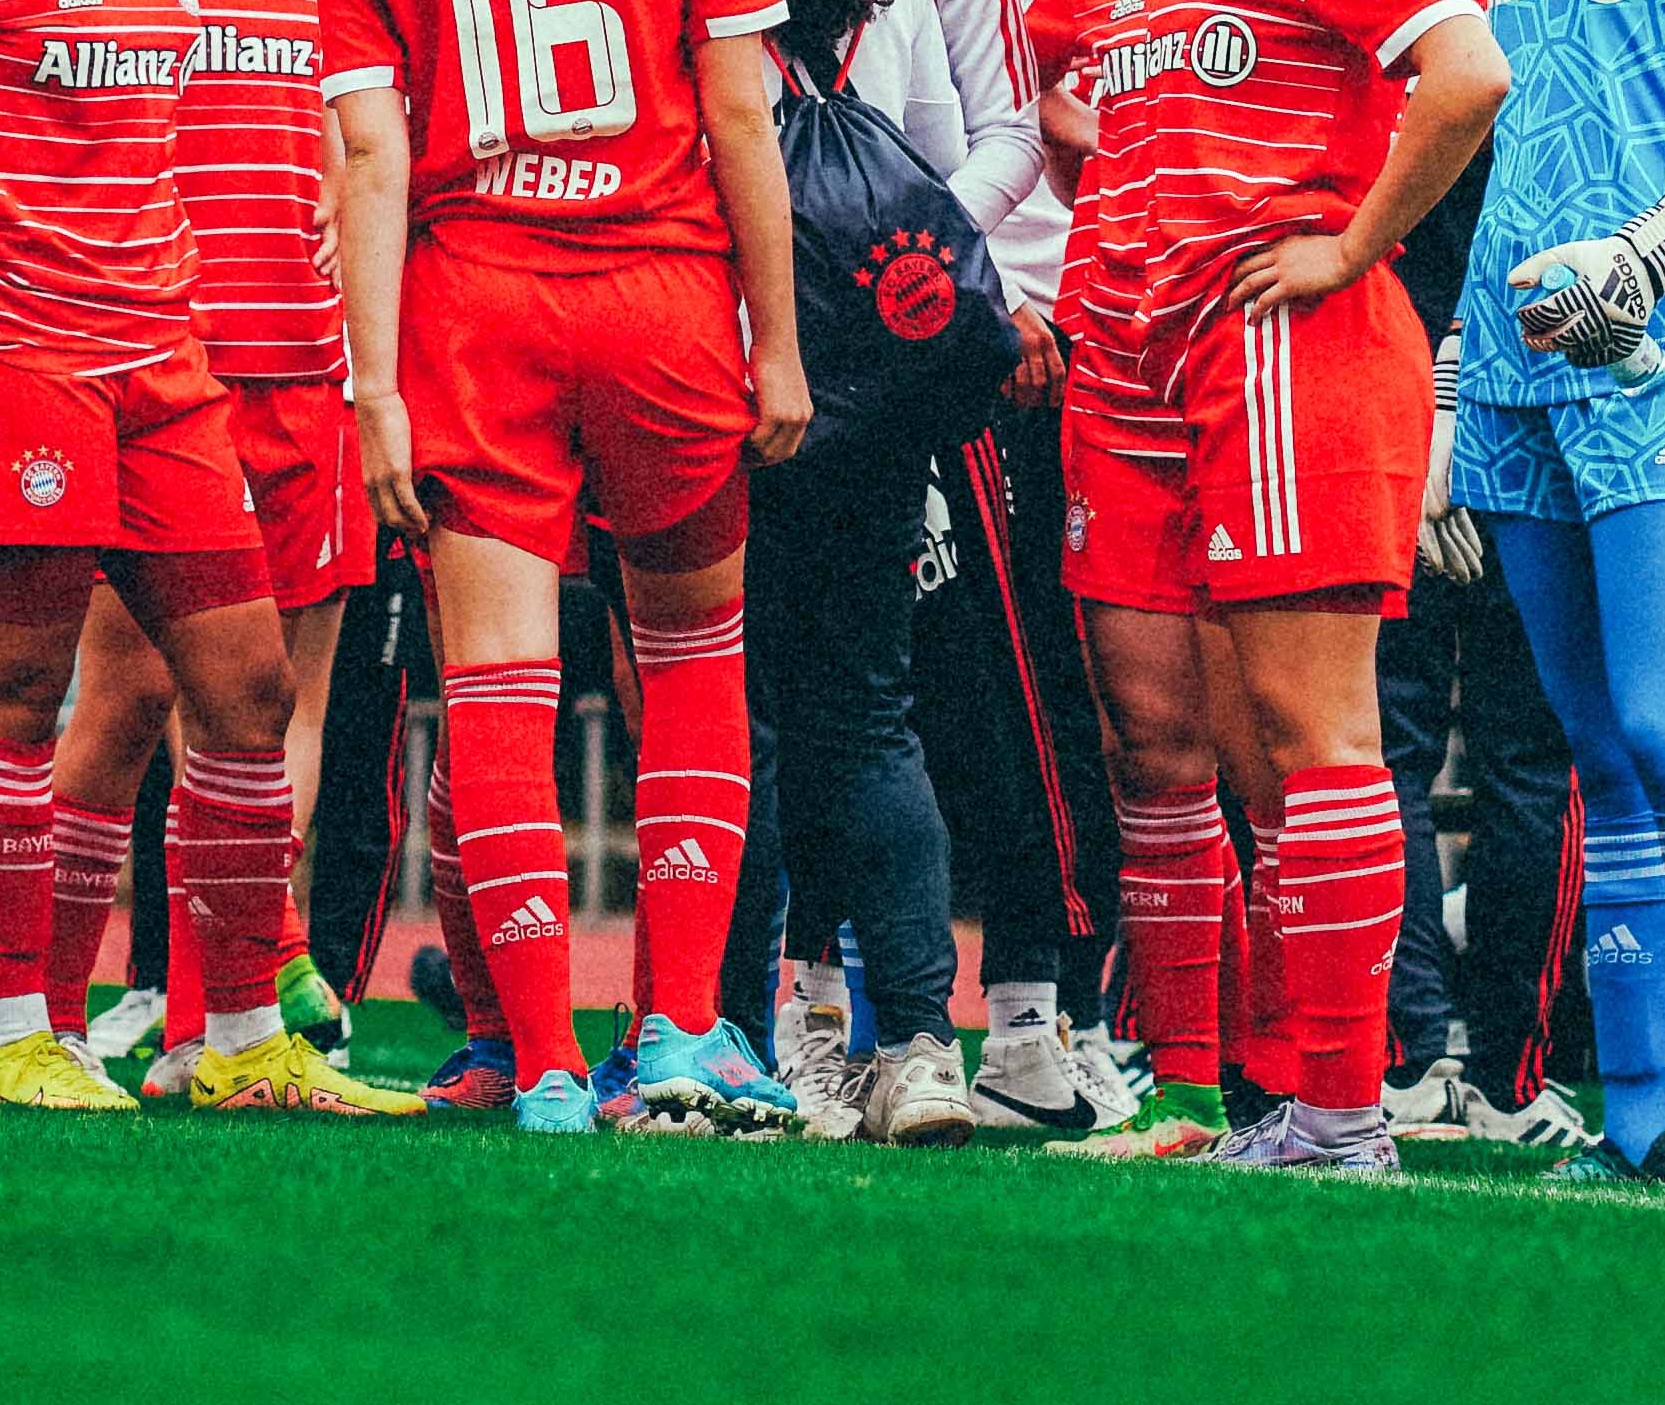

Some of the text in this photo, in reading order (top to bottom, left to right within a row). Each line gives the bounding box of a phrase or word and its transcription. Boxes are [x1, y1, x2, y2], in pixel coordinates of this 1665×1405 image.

[1109, 0, 1146, 20] adidas
[33, 39, 178, 89] Allianz
[190, 25, 314, 77] llianz
[475, 152, 622, 201] WEBER
[1614, 252, 1647, 321] adidas
[1207, 548, 1243, 561] adidas
[3, 833, 53, 855] BAYE
[646, 860, 719, 884] adidas
[491, 919, 564, 945] adidas
